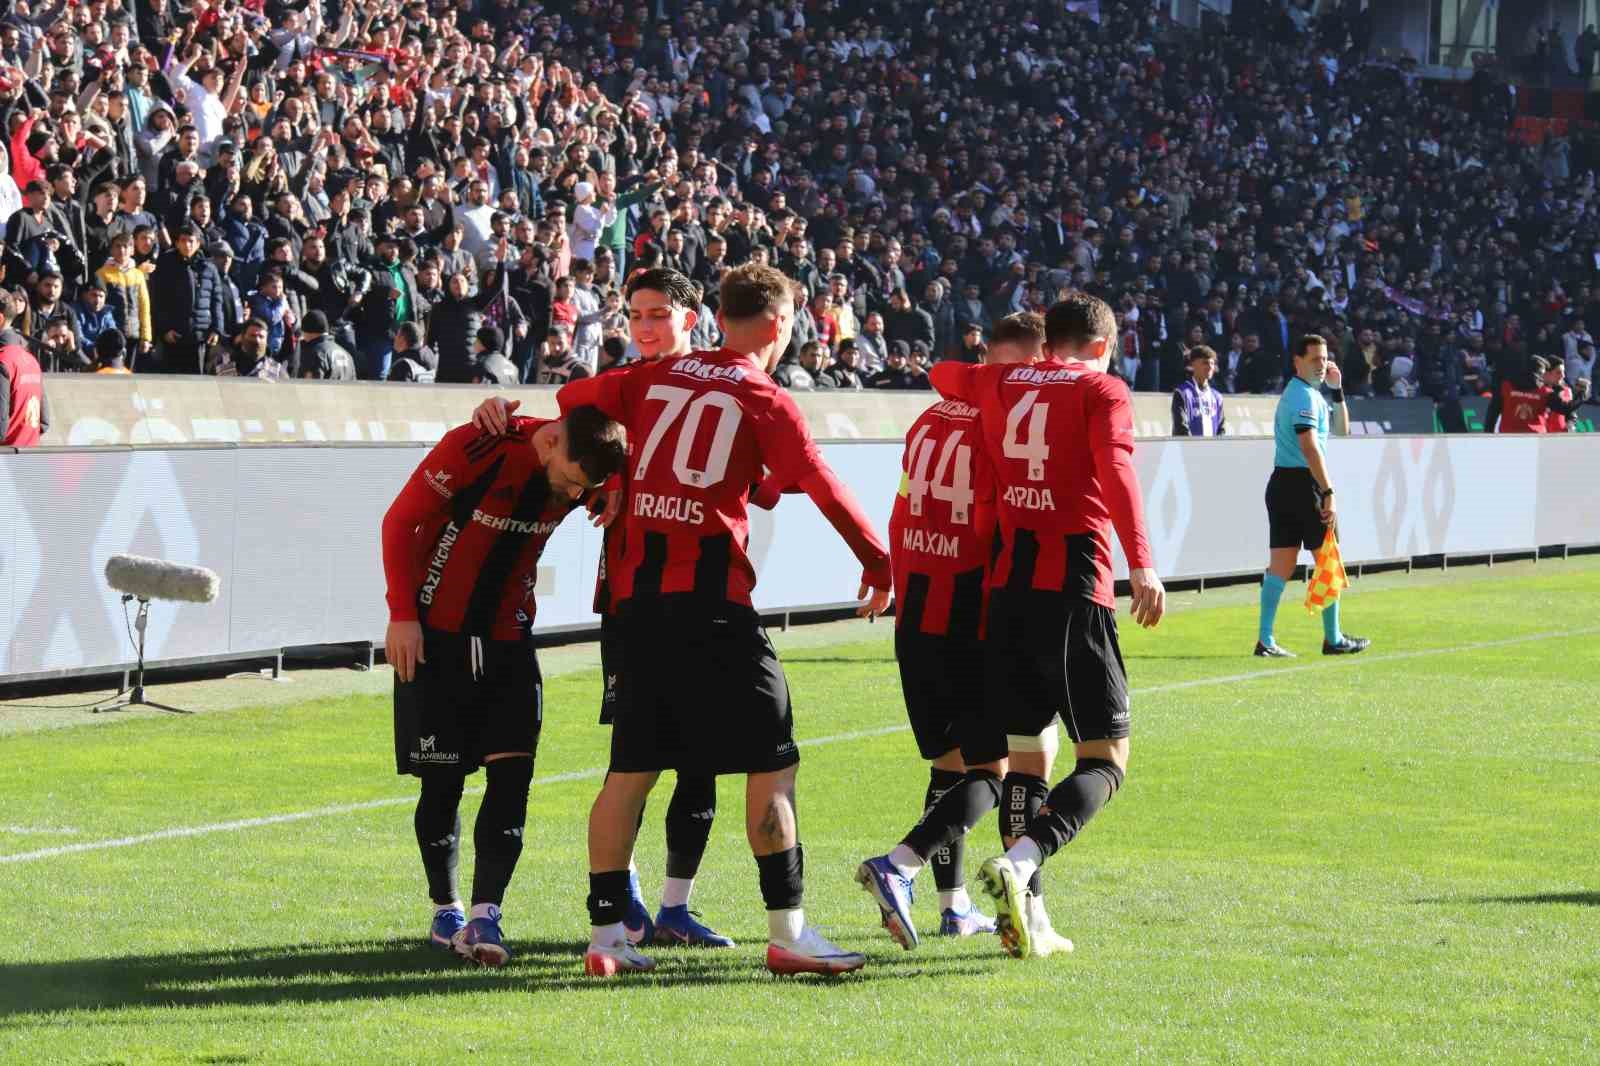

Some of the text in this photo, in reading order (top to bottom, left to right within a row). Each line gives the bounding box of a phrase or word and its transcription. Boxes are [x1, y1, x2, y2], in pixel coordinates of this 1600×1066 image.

[634, 384, 743, 489] 70
[1002, 389, 1051, 481] 4
[906, 424, 974, 525] 44
[1003, 485, 1056, 511] ARDA
[903, 528, 960, 558] MAXIM
[1011, 785, 1027, 811] GBB
